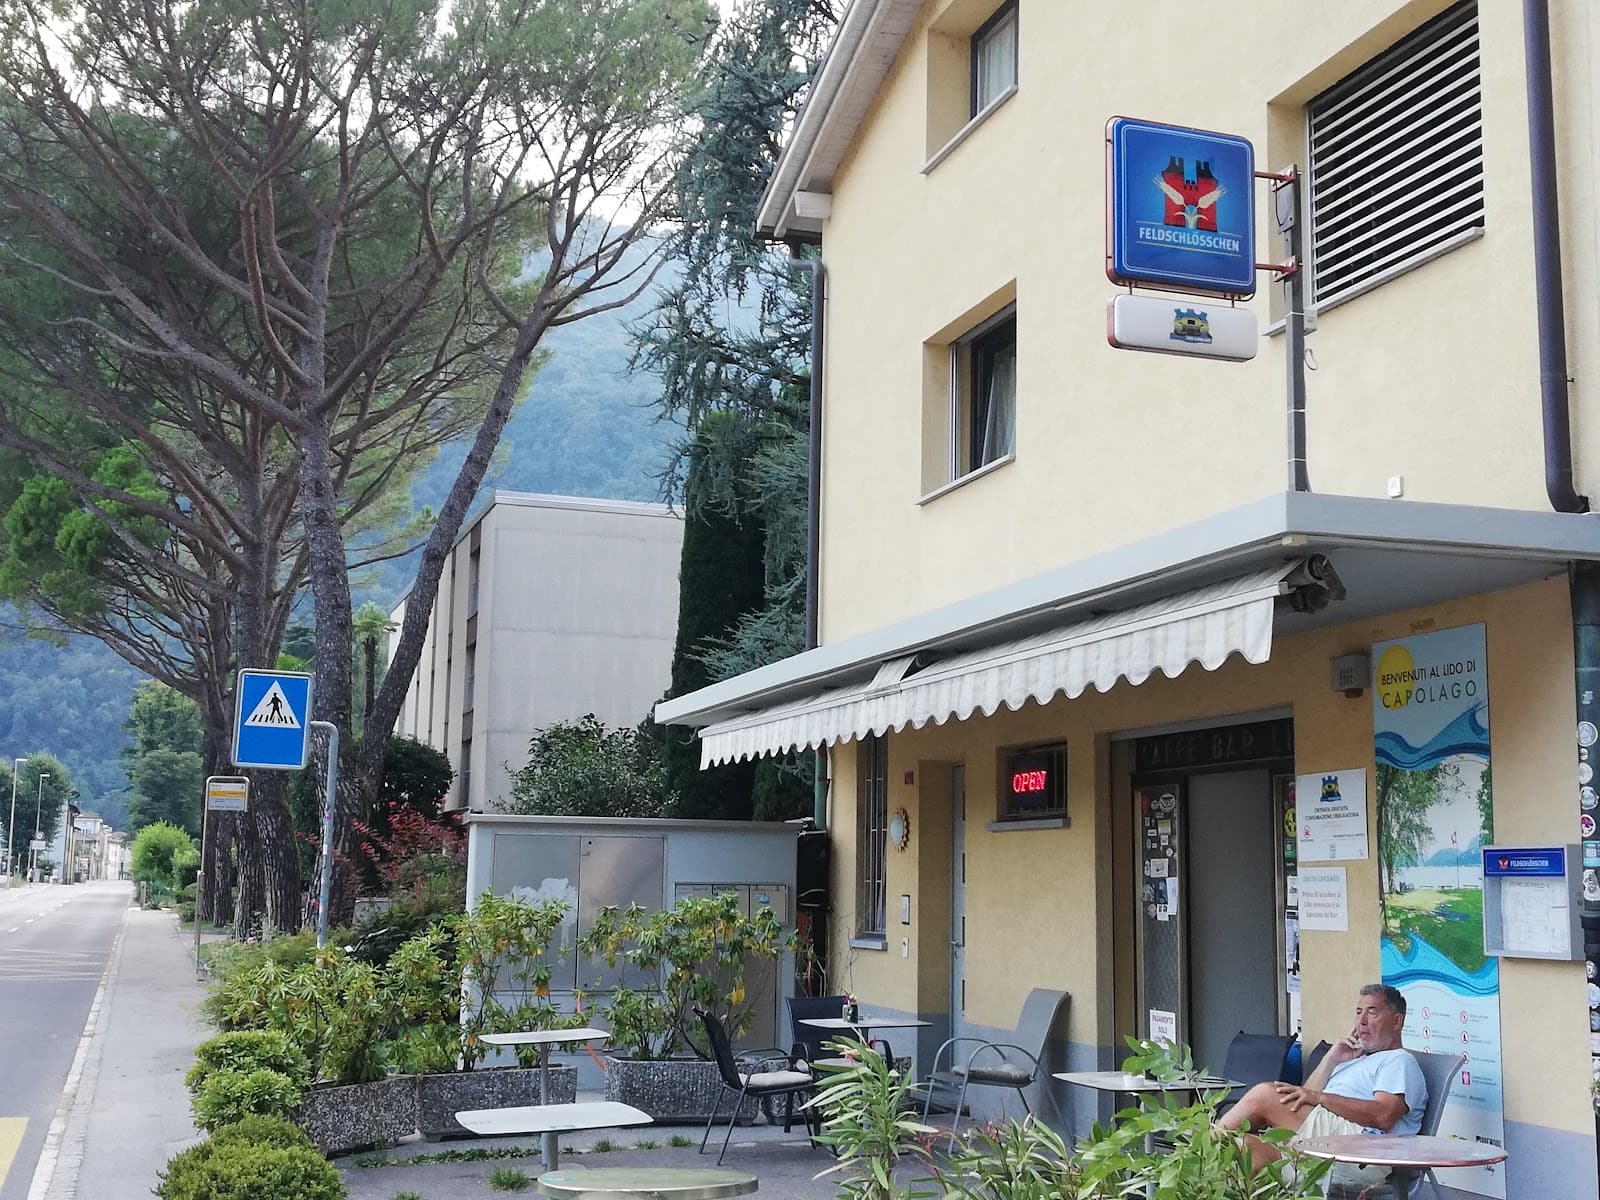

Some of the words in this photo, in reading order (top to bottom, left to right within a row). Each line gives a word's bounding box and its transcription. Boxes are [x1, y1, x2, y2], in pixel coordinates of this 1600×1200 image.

[1139, 227, 1240, 252] FELDSCHLÖSSCHEN
[1381, 668, 1427, 686] BENVENUTI
[1429, 665, 1441, 679] AL
[1443, 662, 1464, 676] LIDO
[1466, 660, 1476, 673] DI
[1382, 680, 1477, 708] CAPOLAGO
[1012, 770, 1047, 793] OPEN
